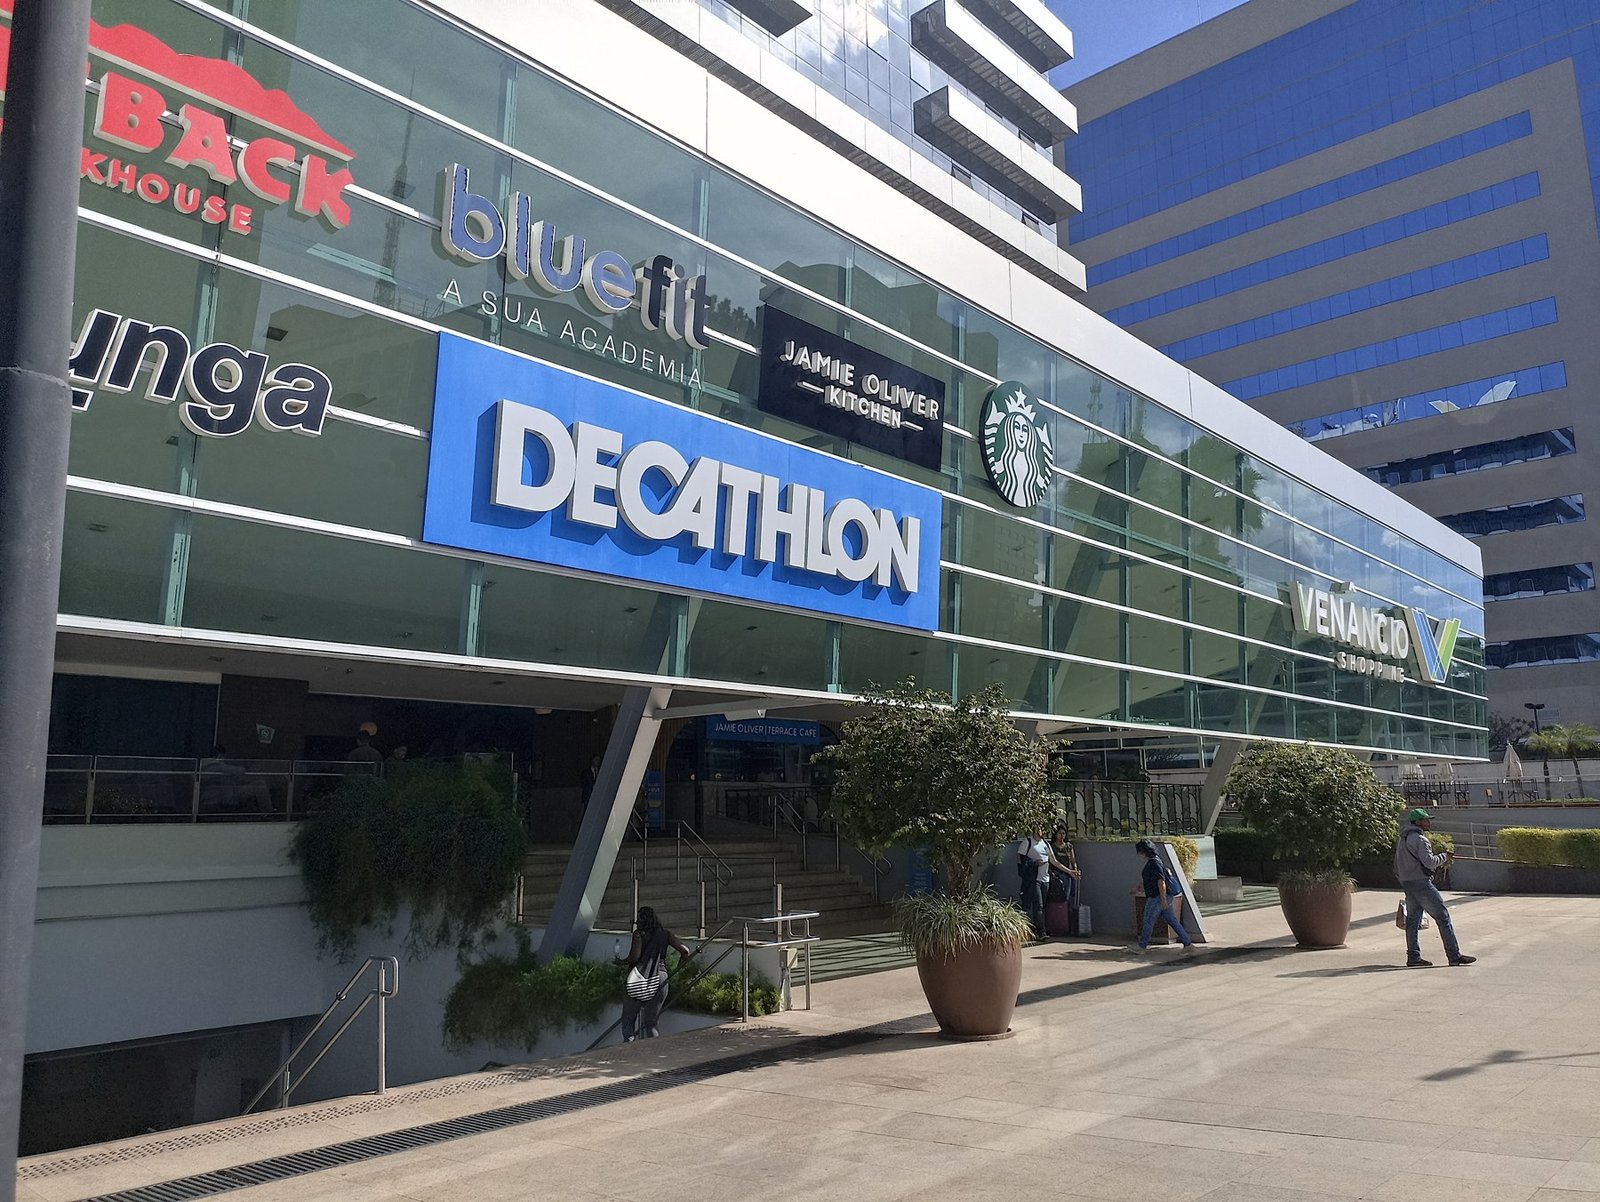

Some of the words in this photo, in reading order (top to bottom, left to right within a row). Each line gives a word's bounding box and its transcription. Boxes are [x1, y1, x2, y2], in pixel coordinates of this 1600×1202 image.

[79, 146, 252, 236] KHOUSE
[85, 63, 353, 229] BACK
[440, 162, 711, 350] bluefit
[68, 302, 333, 437] unga
[442, 278, 463, 305] A
[481, 290, 545, 333] SUA
[559, 319, 702, 390] ACADEMIA
[780, 340, 856, 387] JAMIE
[862, 373, 940, 421] OLIVER
[825, 384, 902, 429] KITCHEN
[491, 399, 921, 593] DECATHLON
[715, 723, 736, 733] JAMIE
[737, 723, 764, 734] OLIVER
[768, 726, 797, 738] TERRACE
